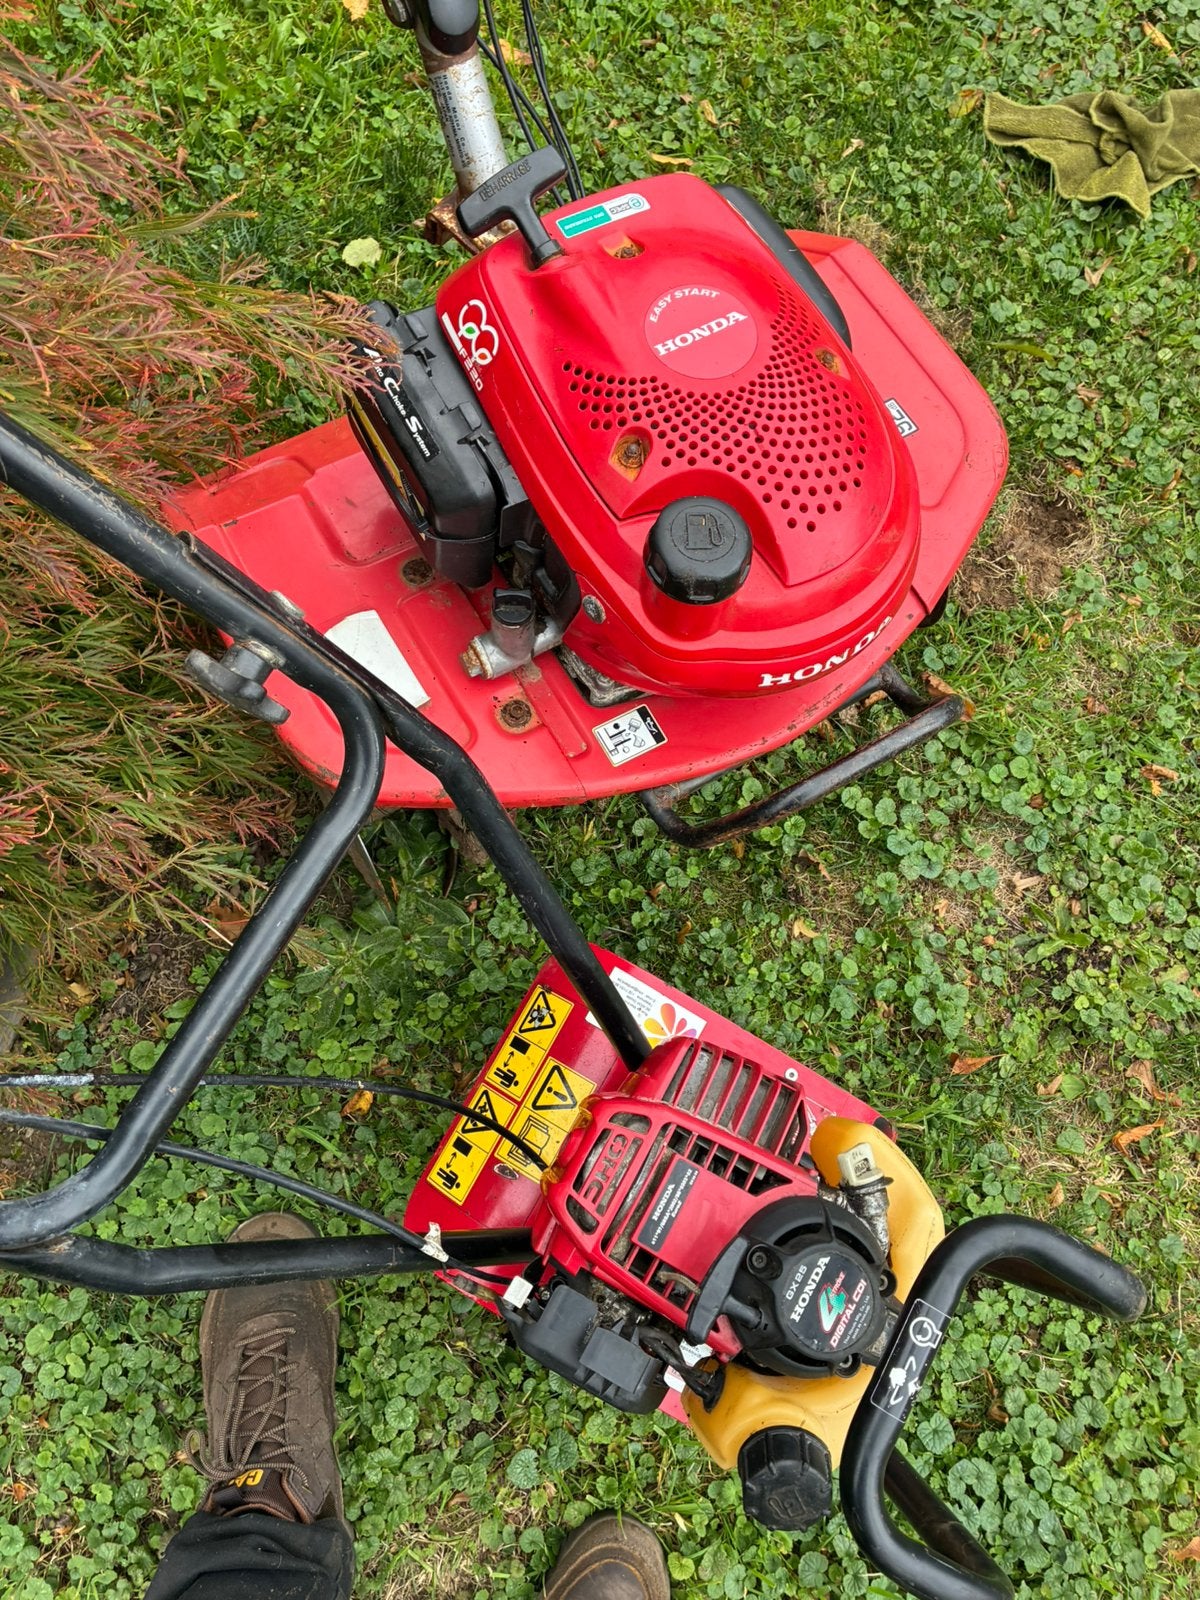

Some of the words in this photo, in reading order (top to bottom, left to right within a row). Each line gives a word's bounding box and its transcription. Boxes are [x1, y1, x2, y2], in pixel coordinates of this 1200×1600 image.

[650, 295, 672, 323] EASY
[673, 287, 720, 298] START
[654, 311, 748, 357] HONDA
[382, 375, 408, 416] Choke
[405, 414, 431, 457] System
[758, 615, 893, 687] HONDA
[652, 1183, 675, 1222] HONDA
[784, 1264, 808, 1300] GX25
[789, 1255, 832, 1323] HONDA
[819, 1285, 847, 1331] 4
[829, 1300, 857, 1348] DIGITAL
[852, 1279, 868, 1303] CDI
